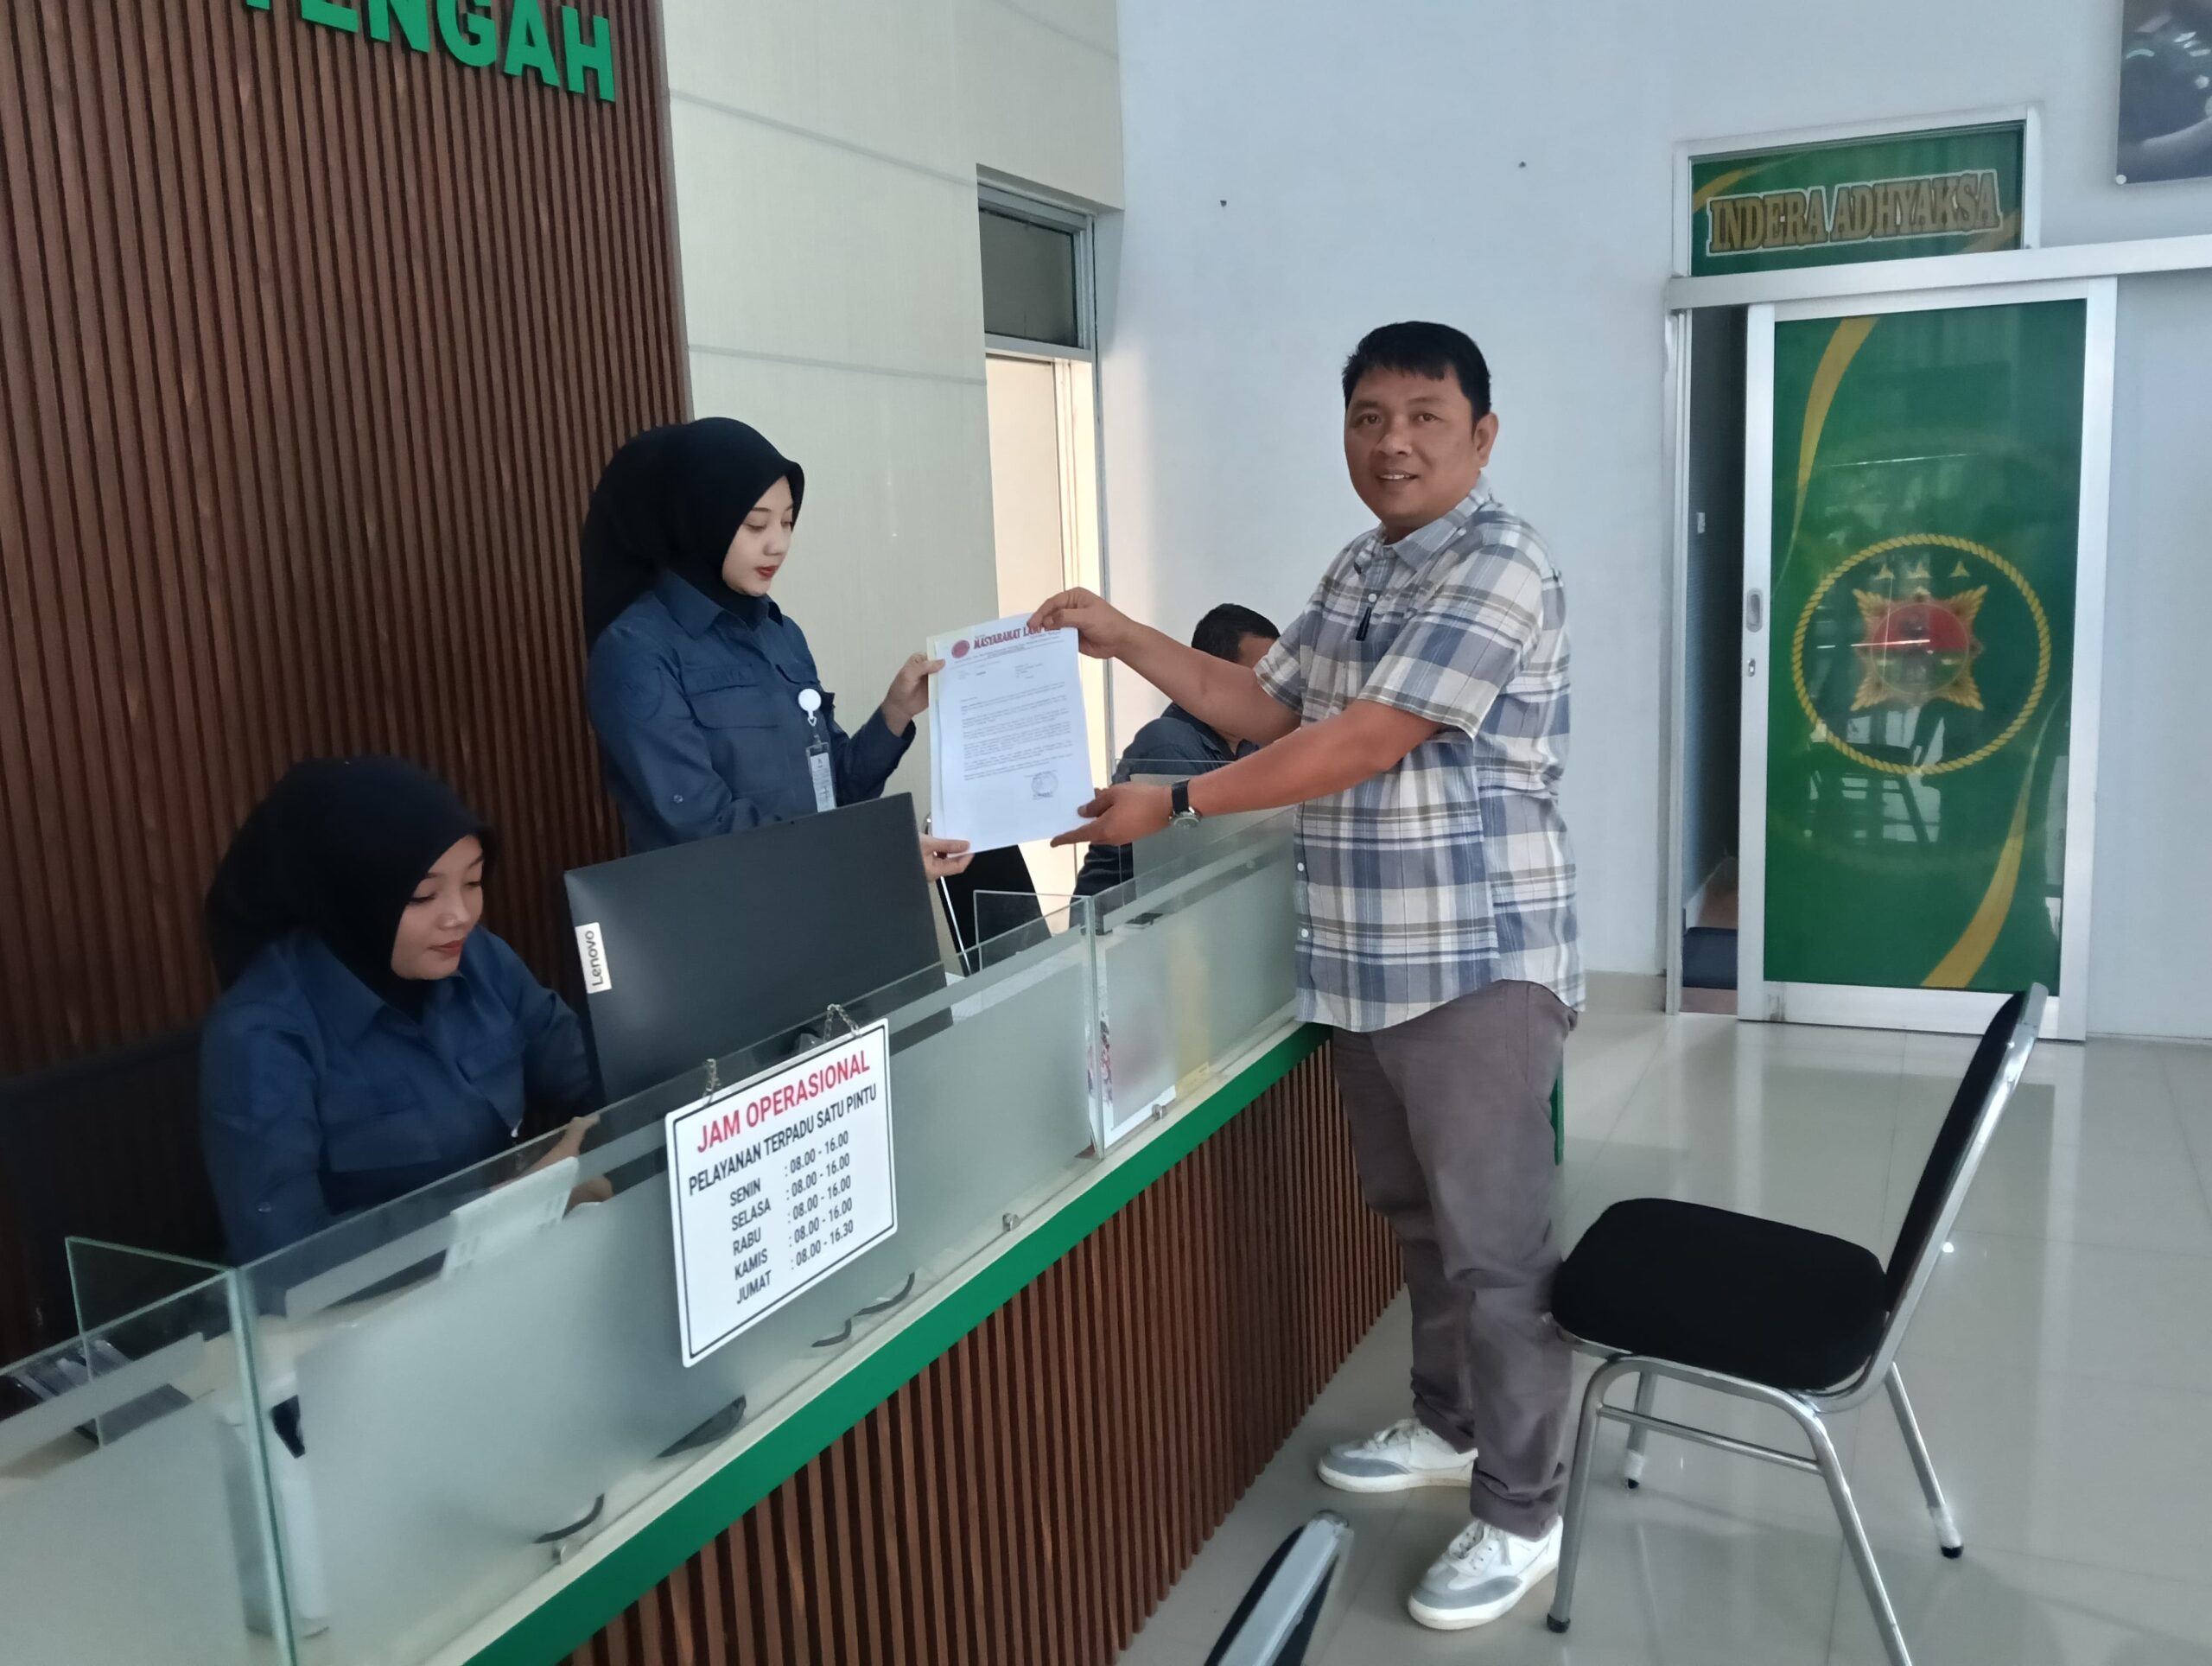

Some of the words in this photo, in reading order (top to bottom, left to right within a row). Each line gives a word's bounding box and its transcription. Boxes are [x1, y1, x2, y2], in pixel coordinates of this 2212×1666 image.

[1709, 189, 1829, 254] INDERA
[1830, 172, 2000, 242] ADHYAKSA
[585, 930, 604, 986] Lenovo
[689, 1142, 762, 1197] PELAYANAN
[764, 1116, 814, 1156] TERPADU
[817, 1099, 844, 1129] SATU
[847, 1083, 877, 1115] PINTU
[697, 1110, 741, 1154] JAM
[746, 1050, 870, 1128] OPERASIONAL
[730, 1178, 761, 1206] SENIN
[790, 1148, 816, 1173] 08.00
[824, 1130, 849, 1154] 16.00
[731, 1199, 771, 1231] SELASA
[791, 1171, 817, 1197] 08.00
[826, 1153, 850, 1177] 16.00
[733, 1227, 761, 1256] RABU
[792, 1194, 818, 1220] 08.00
[827, 1175, 851, 1199] 16.00
[734, 1248, 768, 1280] KAMIS
[794, 1217, 819, 1243] 08.00
[829, 1197, 852, 1222] 16.00
[736, 1269, 772, 1305] JUMAT
[796, 1239, 821, 1266] 08.00
[830, 1219, 854, 1244] 16.30
